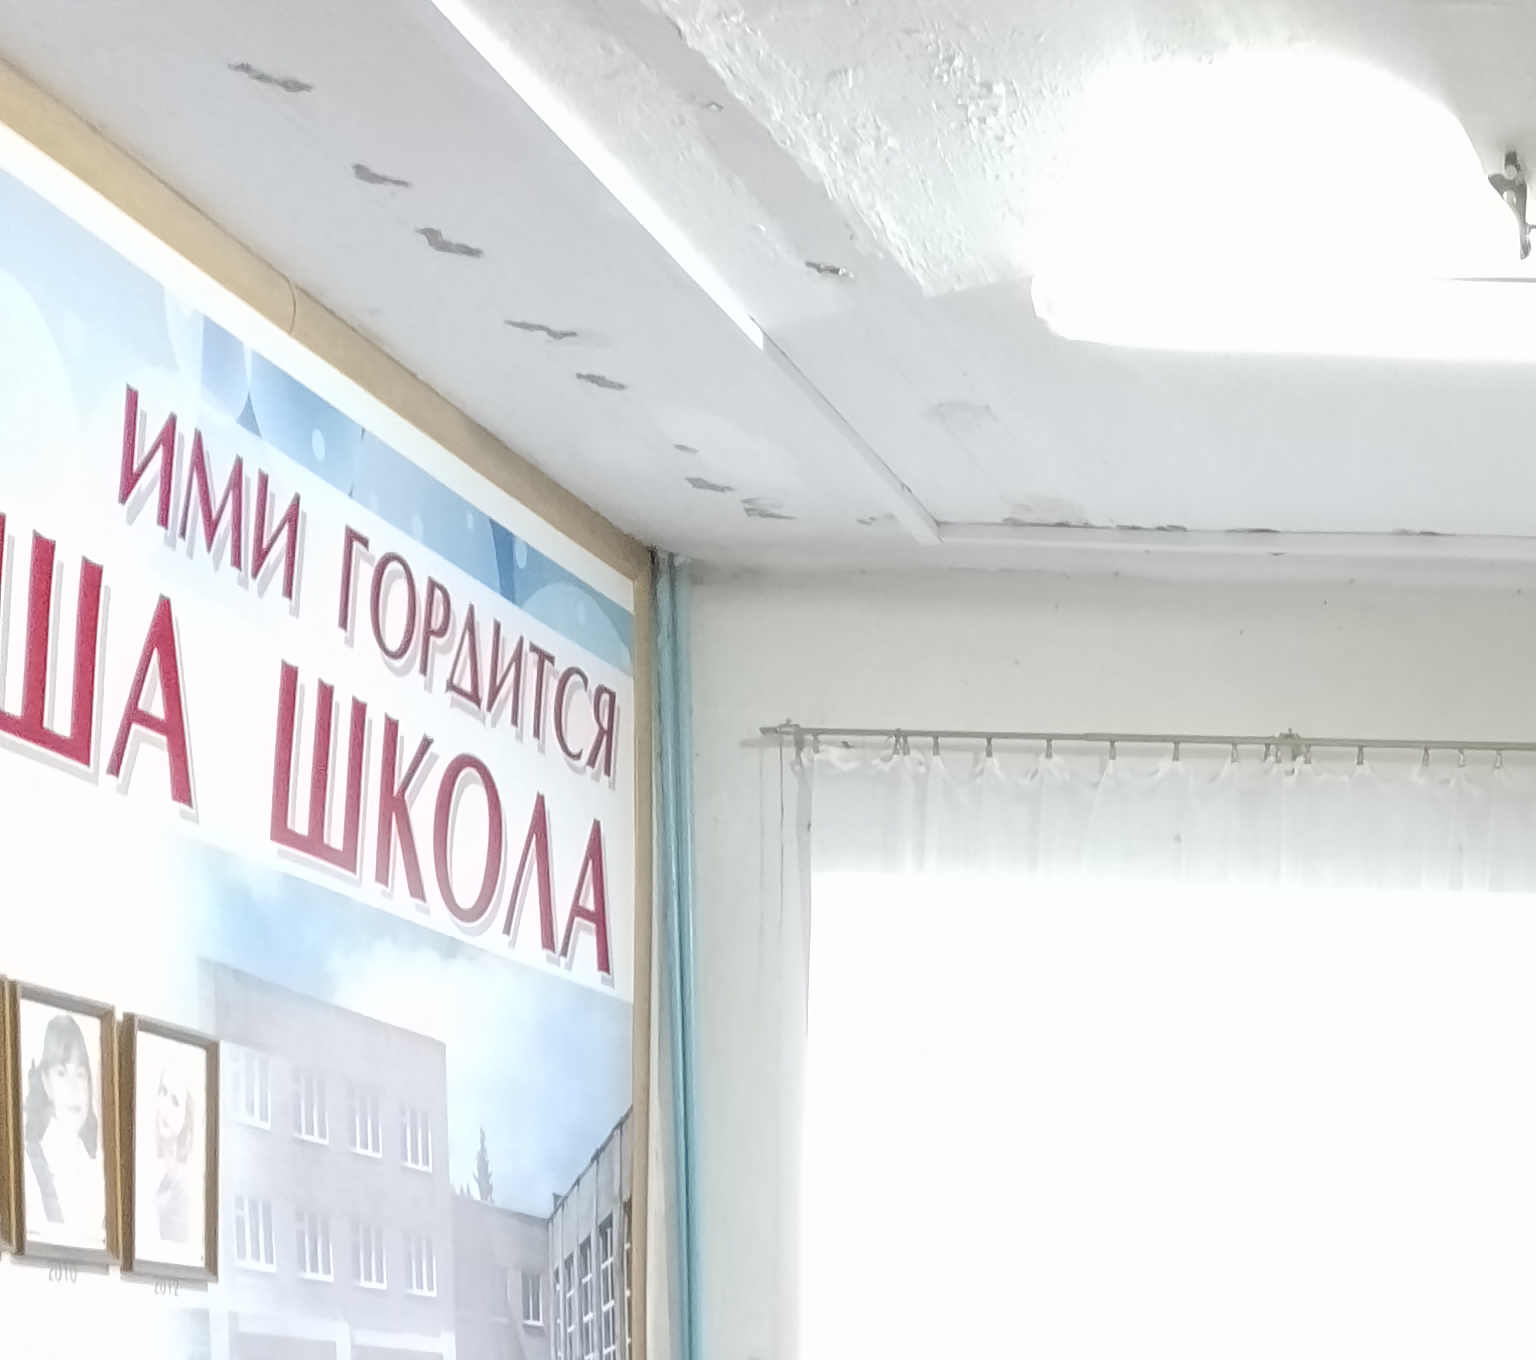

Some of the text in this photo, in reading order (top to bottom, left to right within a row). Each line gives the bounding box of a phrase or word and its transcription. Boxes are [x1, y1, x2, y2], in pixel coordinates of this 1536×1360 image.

[119, 383, 618, 779] ИМИ ГОРДИТСЯ
[270, 660, 613, 975] ШКОЛА
